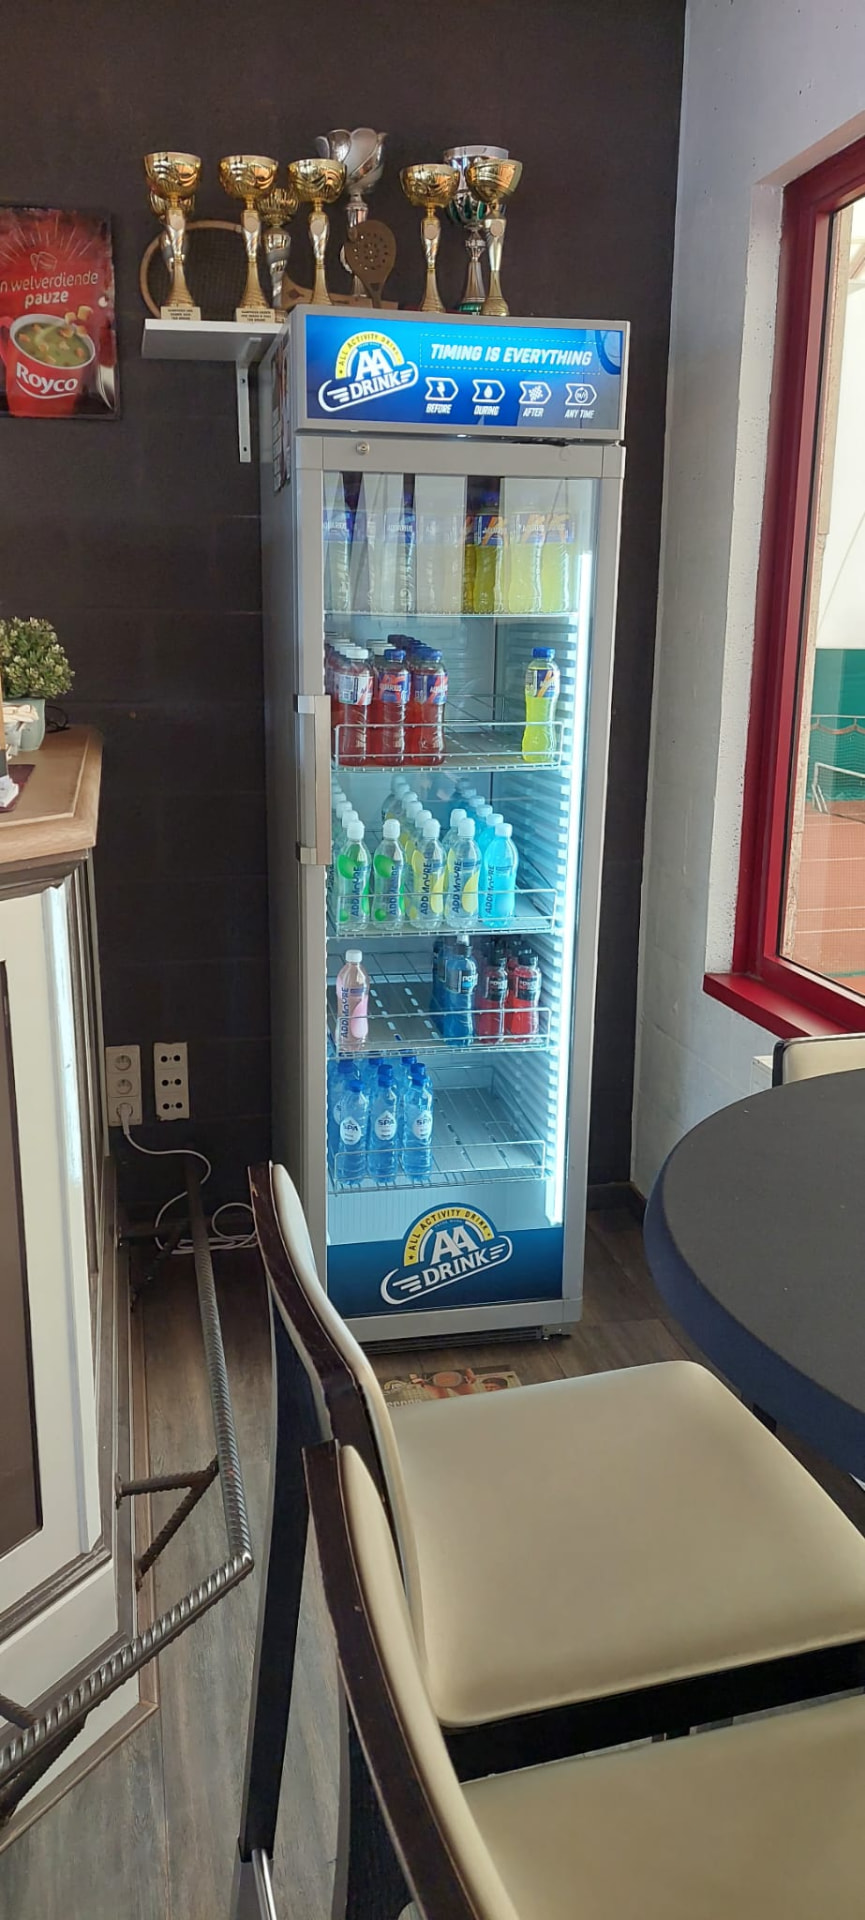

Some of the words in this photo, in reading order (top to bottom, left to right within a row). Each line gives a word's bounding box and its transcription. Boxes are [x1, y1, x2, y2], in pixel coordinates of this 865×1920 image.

[11, 271, 98, 292] welverdiende
[25, 290, 69, 309] pauze
[355, 348, 393, 381] AA
[431, 343, 481, 362] TIMING
[485, 346, 500, 362] IS
[503, 347, 593, 366] EVERYTHING
[16, 361, 78, 394] Royco
[349, 371, 401, 399] DRINK
[425, 403, 452, 414] BEFORE
[474, 405, 500, 416] DURING
[523, 407, 544, 417] AFTER
[565, 409, 579, 418] ANY
[580, 410, 595, 419] TIME
[409, 1233, 420, 1251] ALL
[419, 1208, 461, 1231] ACTIVITY
[464, 1211, 488, 1231] DRINK
[430, 1225, 480, 1266] AA
[422, 1248, 492, 1287] DRINK
